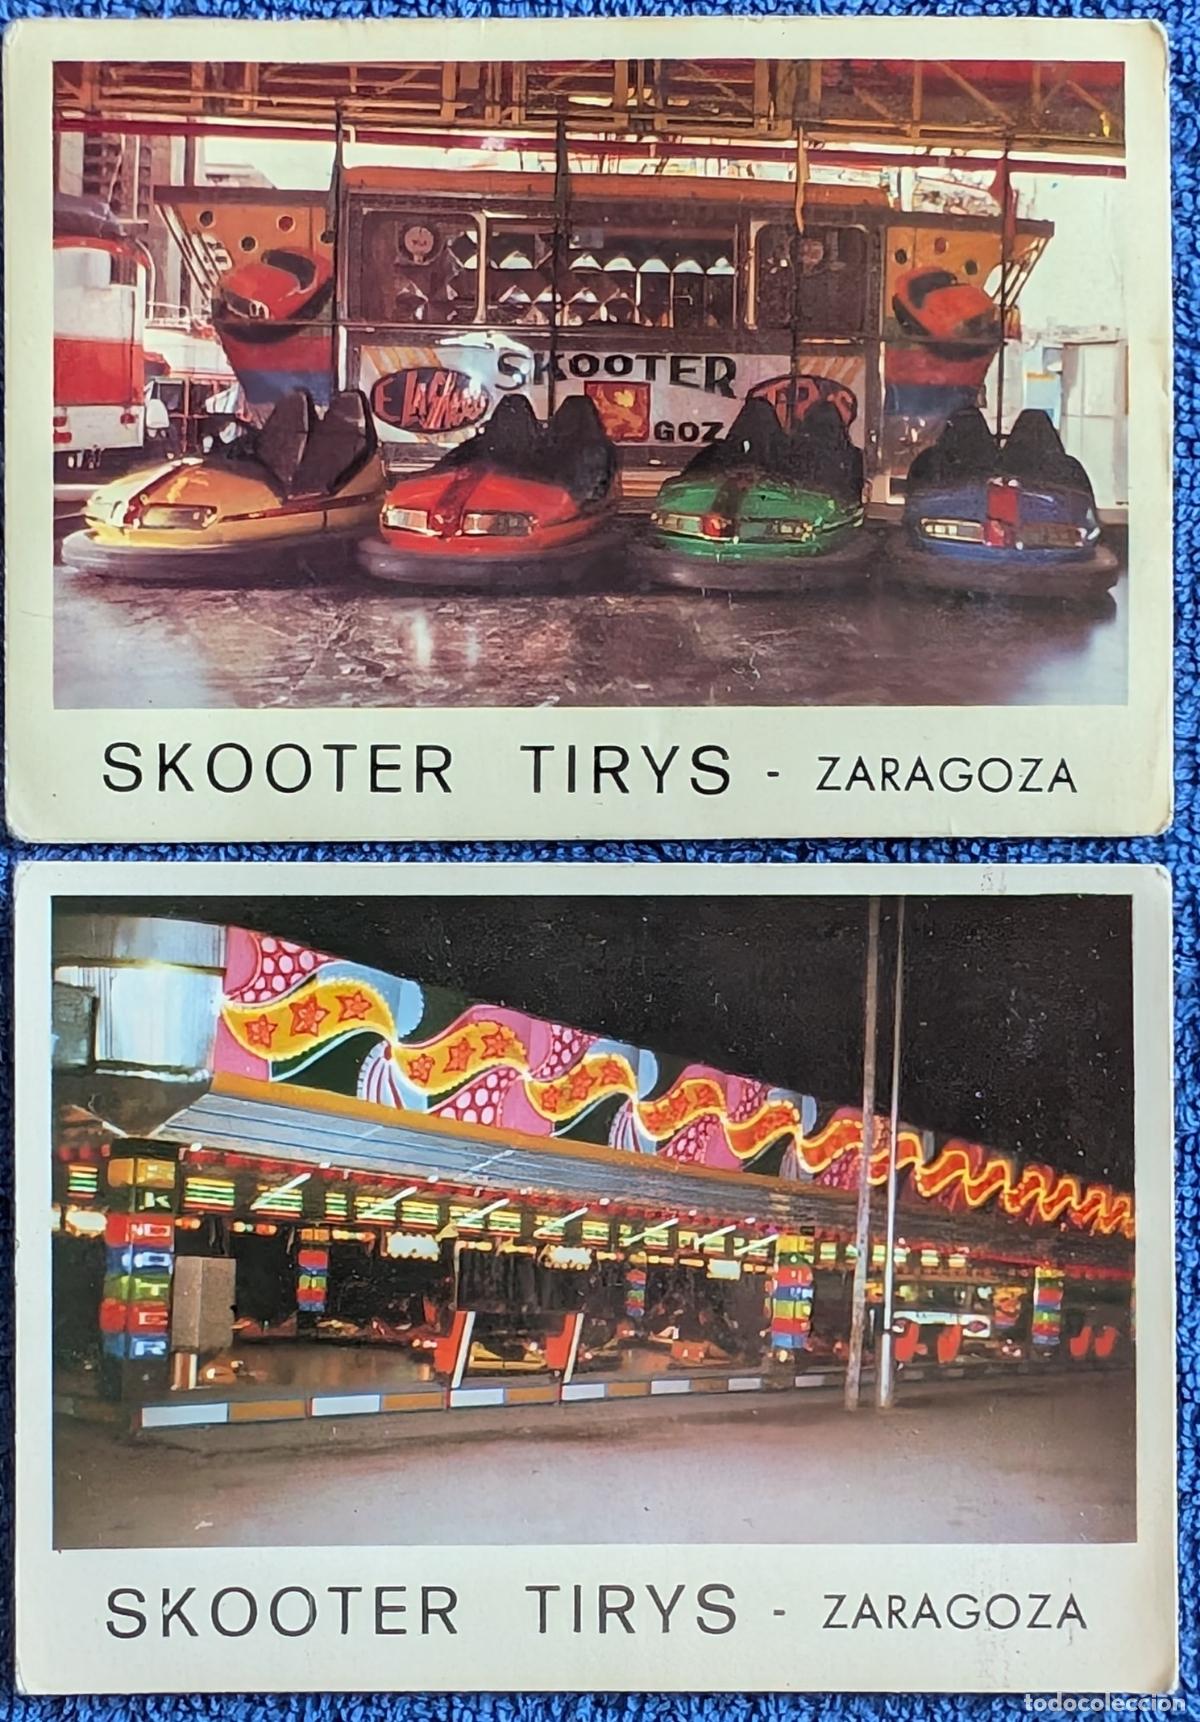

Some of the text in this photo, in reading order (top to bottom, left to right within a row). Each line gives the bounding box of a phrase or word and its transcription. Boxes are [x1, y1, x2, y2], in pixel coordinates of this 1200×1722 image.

[495, 350, 737, 399] SKOOTER
[103, 742, 452, 794] SKOOTER
[520, 743, 730, 796] TIRYS
[816, 756, 1078, 793] ZARAGOZA
[106, 1586, 458, 1639] SKOOTER
[526, 1583, 736, 1634] TIRYS
[822, 1593, 1087, 1630] ZARAGOZA
